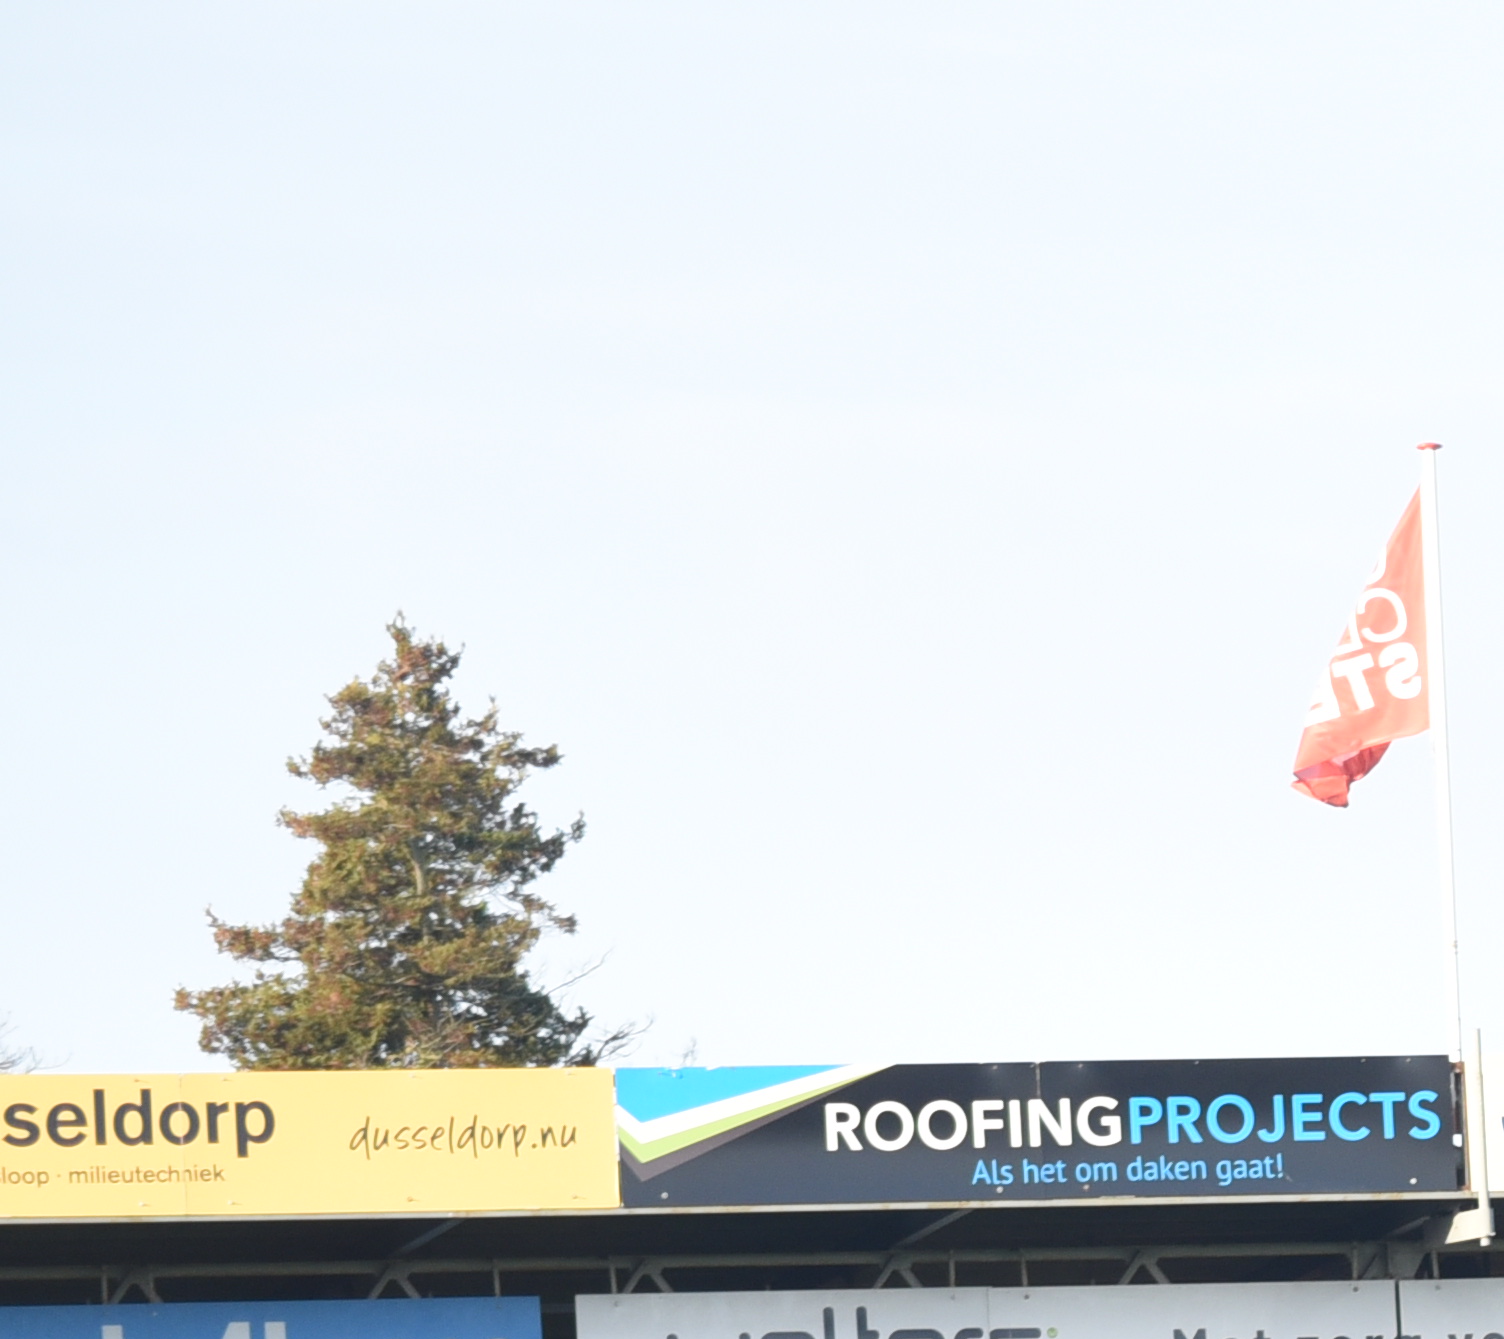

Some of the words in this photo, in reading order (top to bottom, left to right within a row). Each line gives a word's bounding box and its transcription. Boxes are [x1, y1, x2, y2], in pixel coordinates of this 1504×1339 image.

[2, 1088, 276, 1158] seldorp
[349, 1114, 578, 1160] dusseldorp.nu
[0, 1166, 50, 1188] loop
[68, 1164, 225, 1185] milieutechniek
[971, 1158, 1014, 1186] Als
[1022, 1159, 1067, 1184] het
[1075, 1163, 1118, 1182] om
[1126, 1155, 1207, 1181] daken
[1216, 1153, 1285, 1187] gaat!
